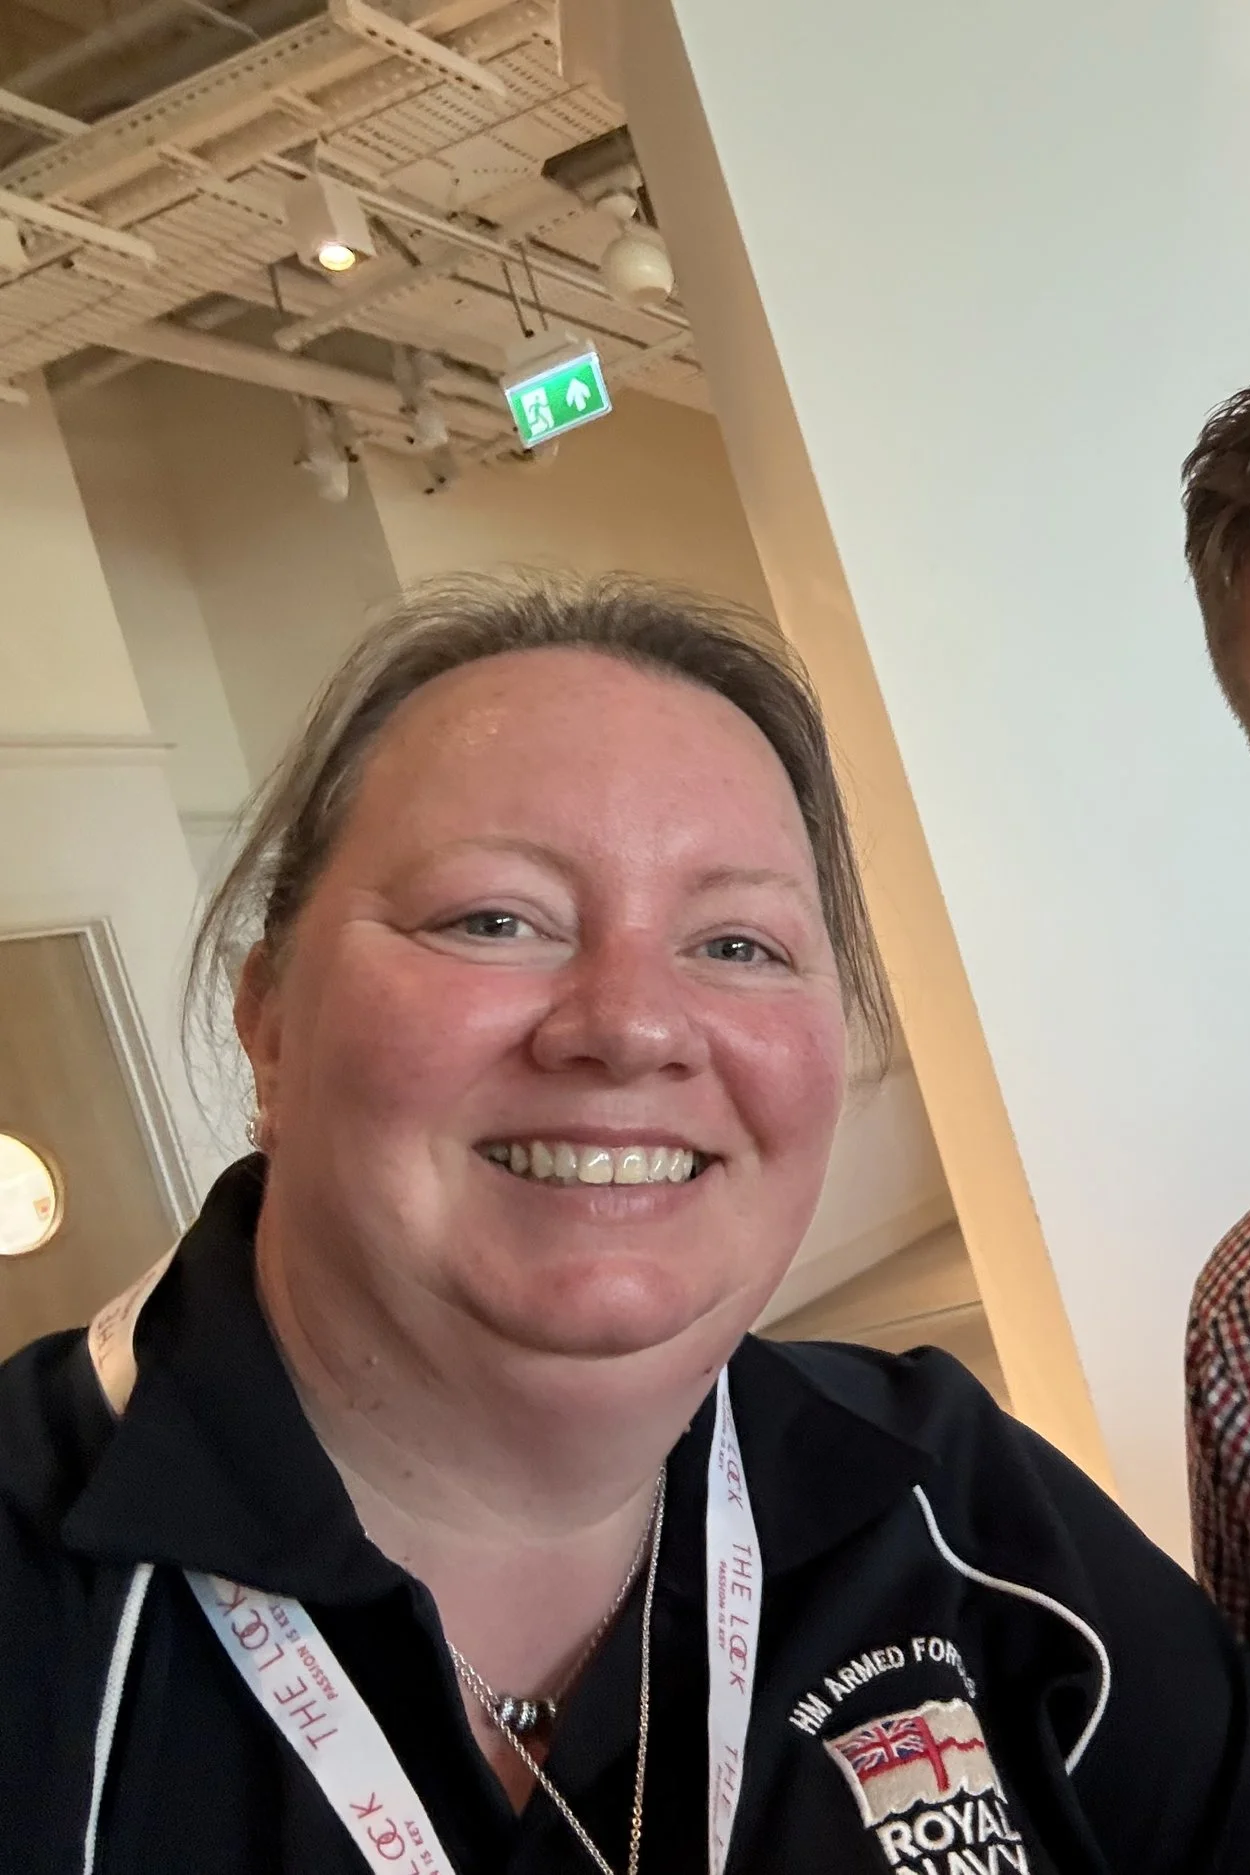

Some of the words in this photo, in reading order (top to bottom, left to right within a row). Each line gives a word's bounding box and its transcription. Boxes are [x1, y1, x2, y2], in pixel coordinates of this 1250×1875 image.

[731, 1543, 753, 1601] THE
[215, 1583, 285, 1672] LOCK
[268, 1603, 291, 1629] KEY
[285, 1628, 301, 1643] IS
[297, 1643, 339, 1701] PASSION
[729, 1614, 749, 1696] LOCK
[273, 1675, 339, 1751] THE
[788, 1692, 833, 1736] HM
[823, 1645, 906, 1702] ARMED
[404, 1820, 424, 1847] KEY
[875, 1799, 1023, 1866] ROYAL
